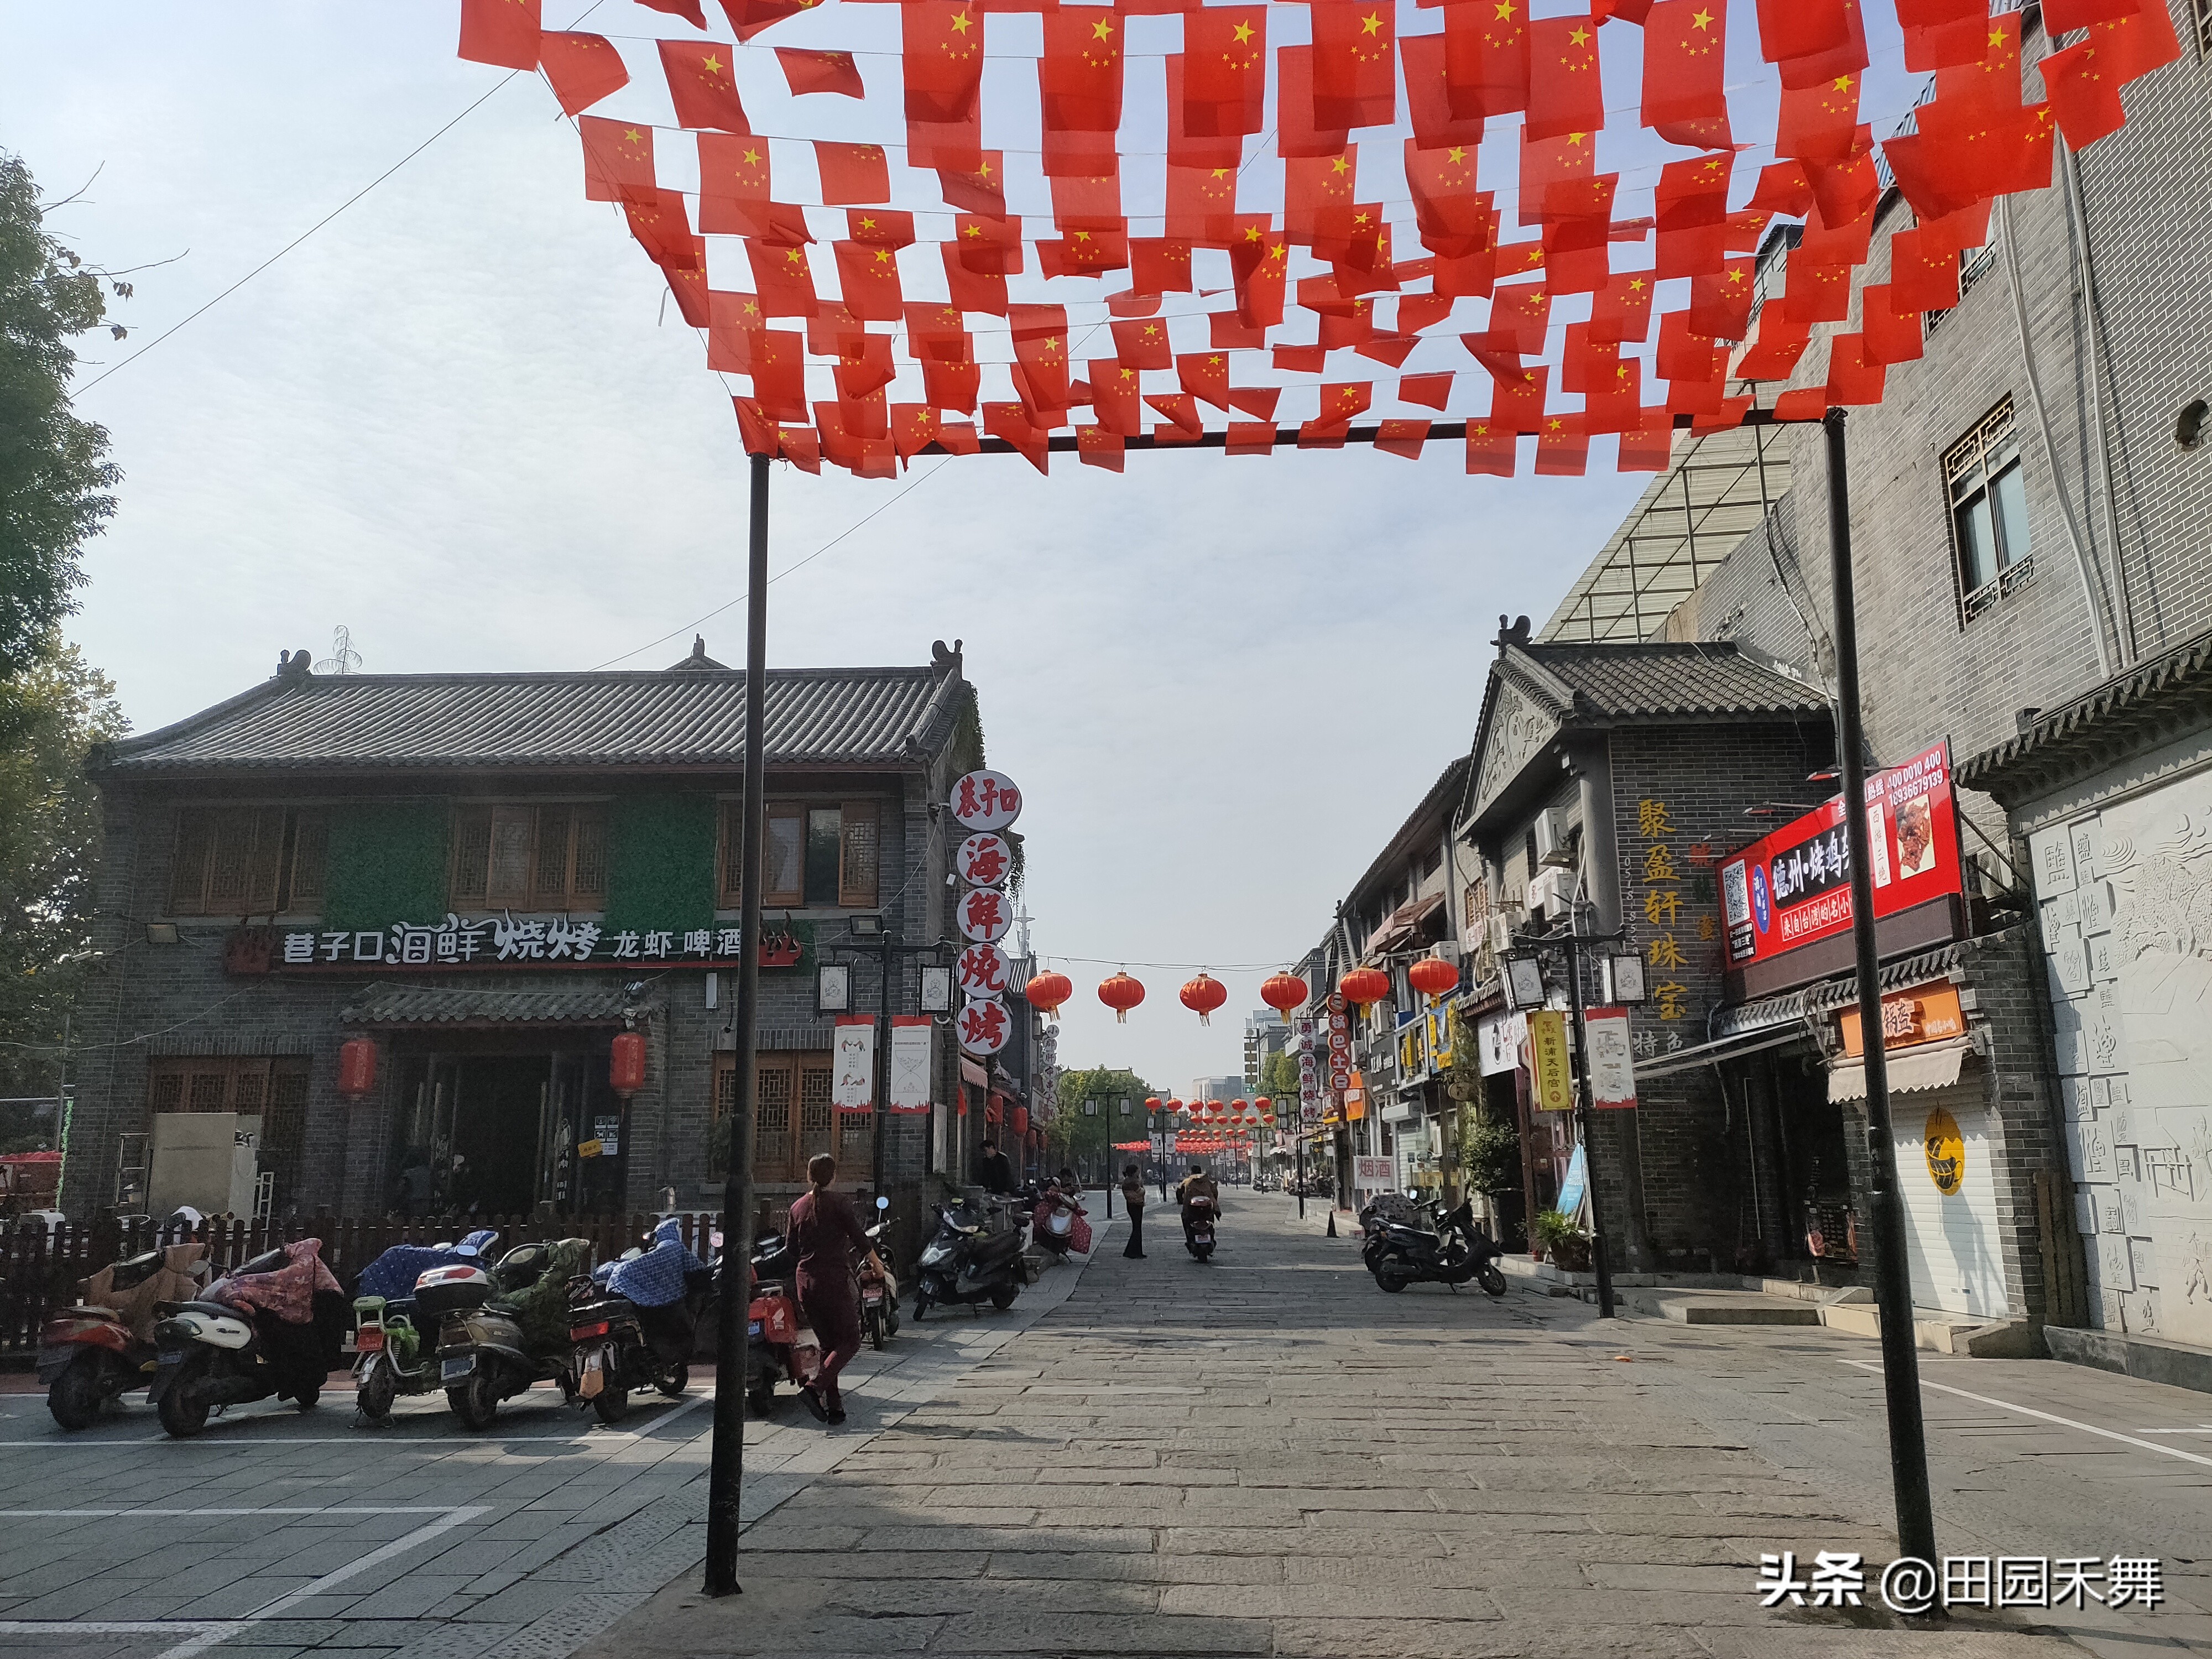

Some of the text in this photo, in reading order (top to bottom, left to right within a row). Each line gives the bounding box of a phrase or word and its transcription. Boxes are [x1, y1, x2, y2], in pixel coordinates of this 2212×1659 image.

[1888, 769, 1943, 807] 18936679139
[1902, 761, 1923, 782] 0010
[1924, 750, 1942, 770] 400
[957, 777, 1019, 817] 巷子口
[1638, 799, 1689, 1020] 聚盈轩珠宝
[1784, 893, 1853, 937] 来自台湾的名小
[284, 907, 740, 966] 巷子口海鲜烧烤 龙虾 啤酒
[1331, 1014, 1348, 1089] 锅巴土豆
[1543, 1037, 1560, 1088] 新浦天后宫
[1632, 1030, 1683, 1058] 特色
[1300, 1022, 1316, 1118] 勇诚海鲜烧烤
[1359, 1159, 1390, 1178] 烟酒
